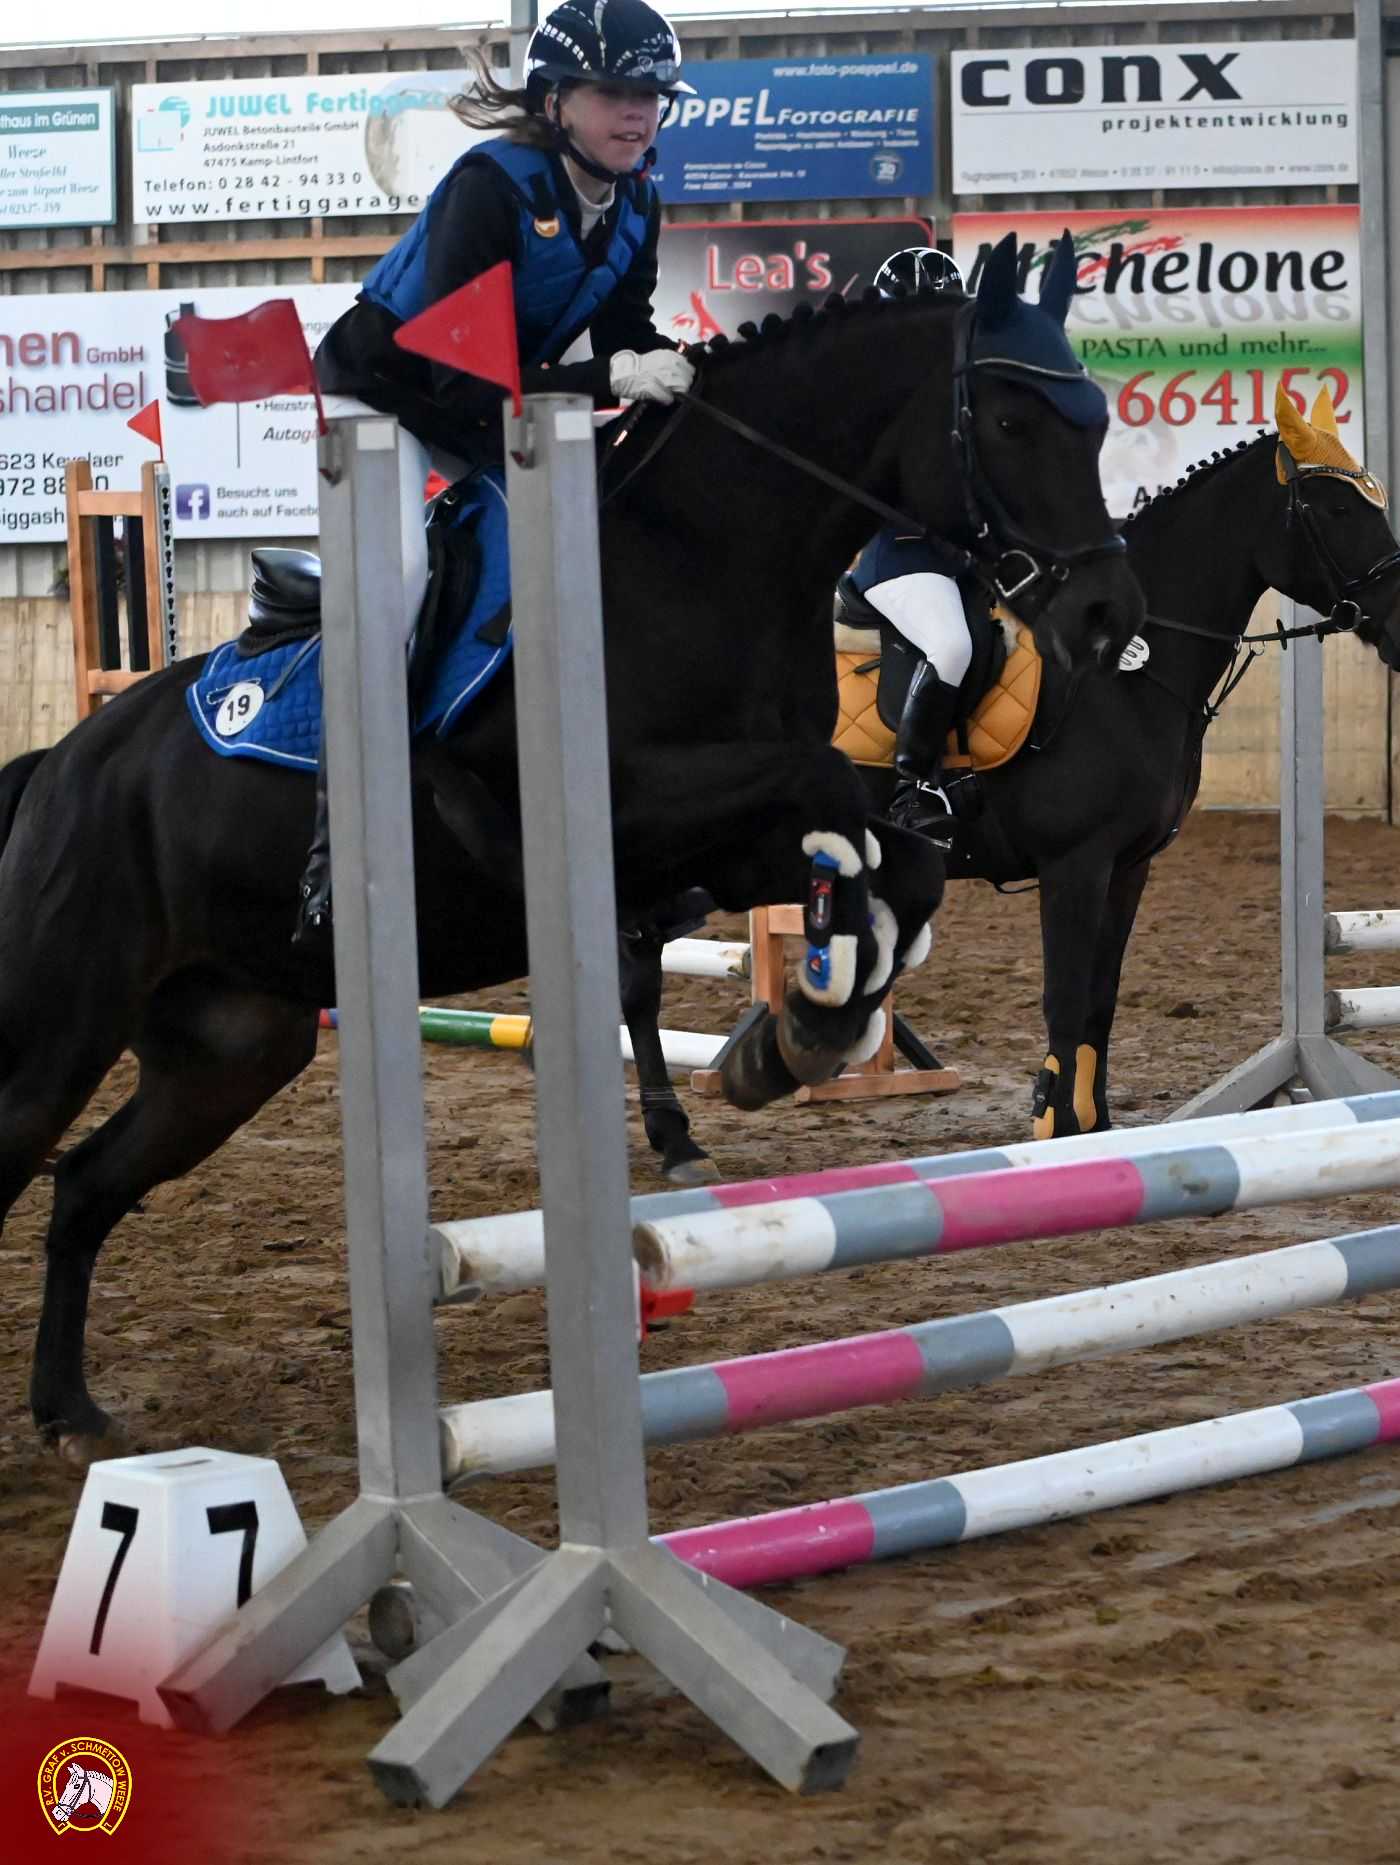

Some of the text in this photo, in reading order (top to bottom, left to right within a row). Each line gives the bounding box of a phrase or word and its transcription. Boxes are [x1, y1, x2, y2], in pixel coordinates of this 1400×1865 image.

[960, 52, 1243, 107] conx
[206, 93, 292, 118] JUWEL
[0, 110, 95, 128] thaus im Grünen
[776, 108, 919, 125] FOTOGRAFIE
[1101, 111, 1349, 133] projektentwicklung
[203, 126, 239, 137] JUWEL
[324, 121, 359, 132] GmbH
[203, 157, 237, 168] 47475
[144, 178, 213, 193] Telefon:
[235, 176, 254, 188] 28
[261, 175, 280, 187] 42
[299, 173, 319, 186] 94
[327, 172, 345, 185] 33
[706, 241, 833, 293] Lea's
[87, 346, 144, 364] GmbH
[1080, 338, 1166, 360] PASTA
[1179, 333, 1229, 357] und
[216, 486, 299, 499] Besucht uns
[217, 506, 249, 519] auch
[252, 504, 273, 517] auf
[226, 694, 251, 722] 19
[206, 1500, 260, 1611] 7
[89, 1500, 140, 1656] 7
